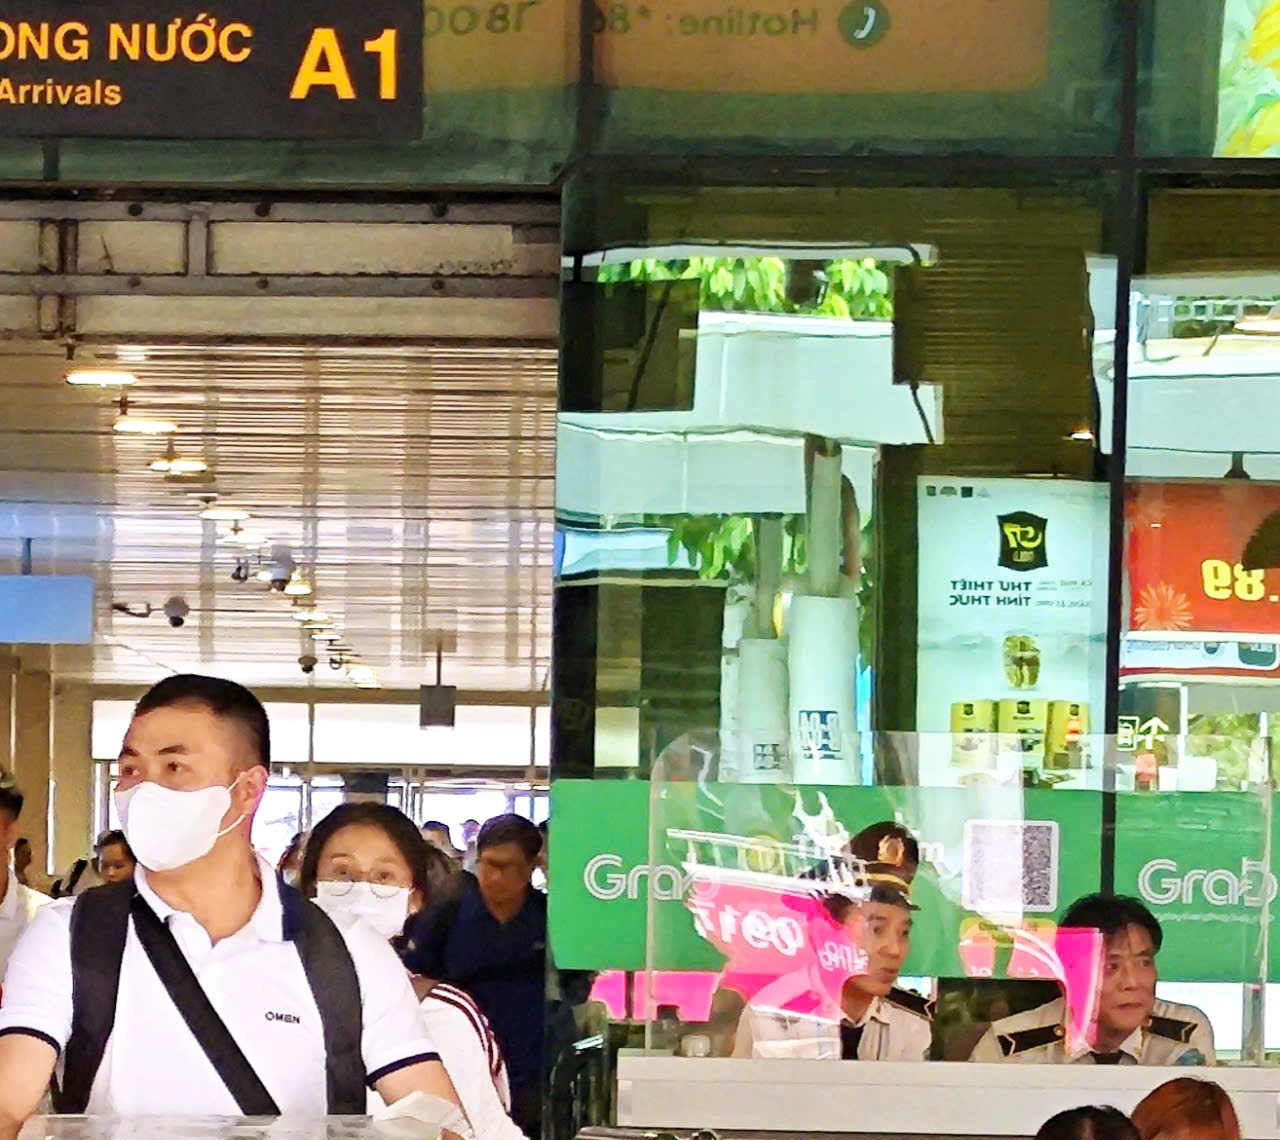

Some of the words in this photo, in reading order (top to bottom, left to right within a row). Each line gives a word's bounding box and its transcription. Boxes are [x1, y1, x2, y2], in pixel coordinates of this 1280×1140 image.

[108, 14, 252, 62] NƯỚC
[288, 28, 398, 100] A1
[1138, 856, 1279, 906] Grab
[265, 1011, 300, 1025] OMEN
